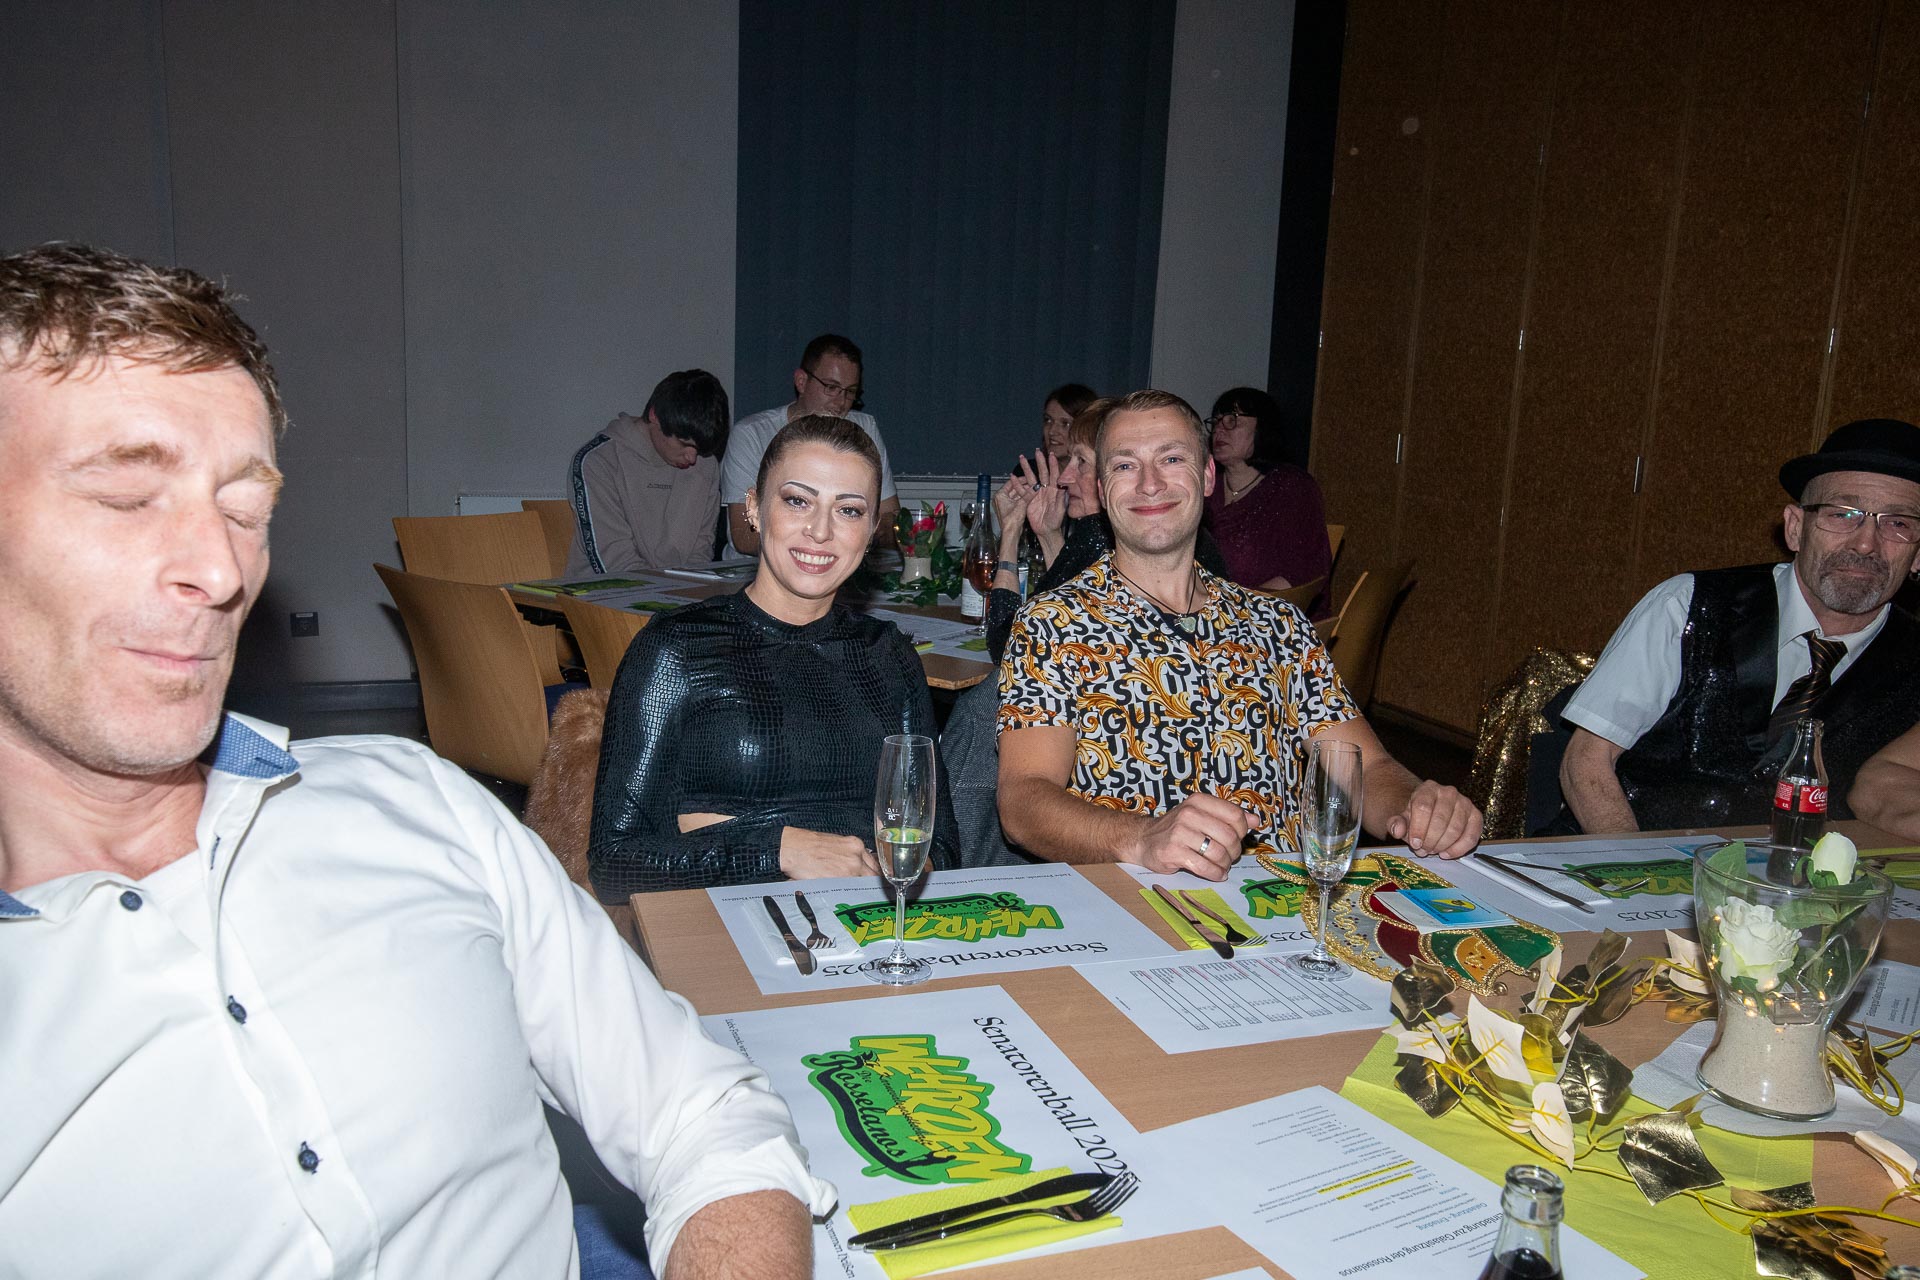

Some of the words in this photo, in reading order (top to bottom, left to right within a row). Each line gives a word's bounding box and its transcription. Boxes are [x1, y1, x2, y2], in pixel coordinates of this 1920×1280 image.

[861, 893, 1020, 916] Rosselaos
[1617, 909, 1678, 922] 2025
[1270, 930, 1316, 942] 025
[914, 942, 1109, 968] Senatorenba
[821, 964, 875, 978] 025
[973, 1016, 1099, 1135] Senatorenball
[1453, 1226, 1469, 1239] zur
[1402, 1234, 1456, 1255] Galasitzung
[1392, 1250, 1406, 1261] der
[1338, 1256, 1393, 1277] Rosselanos
